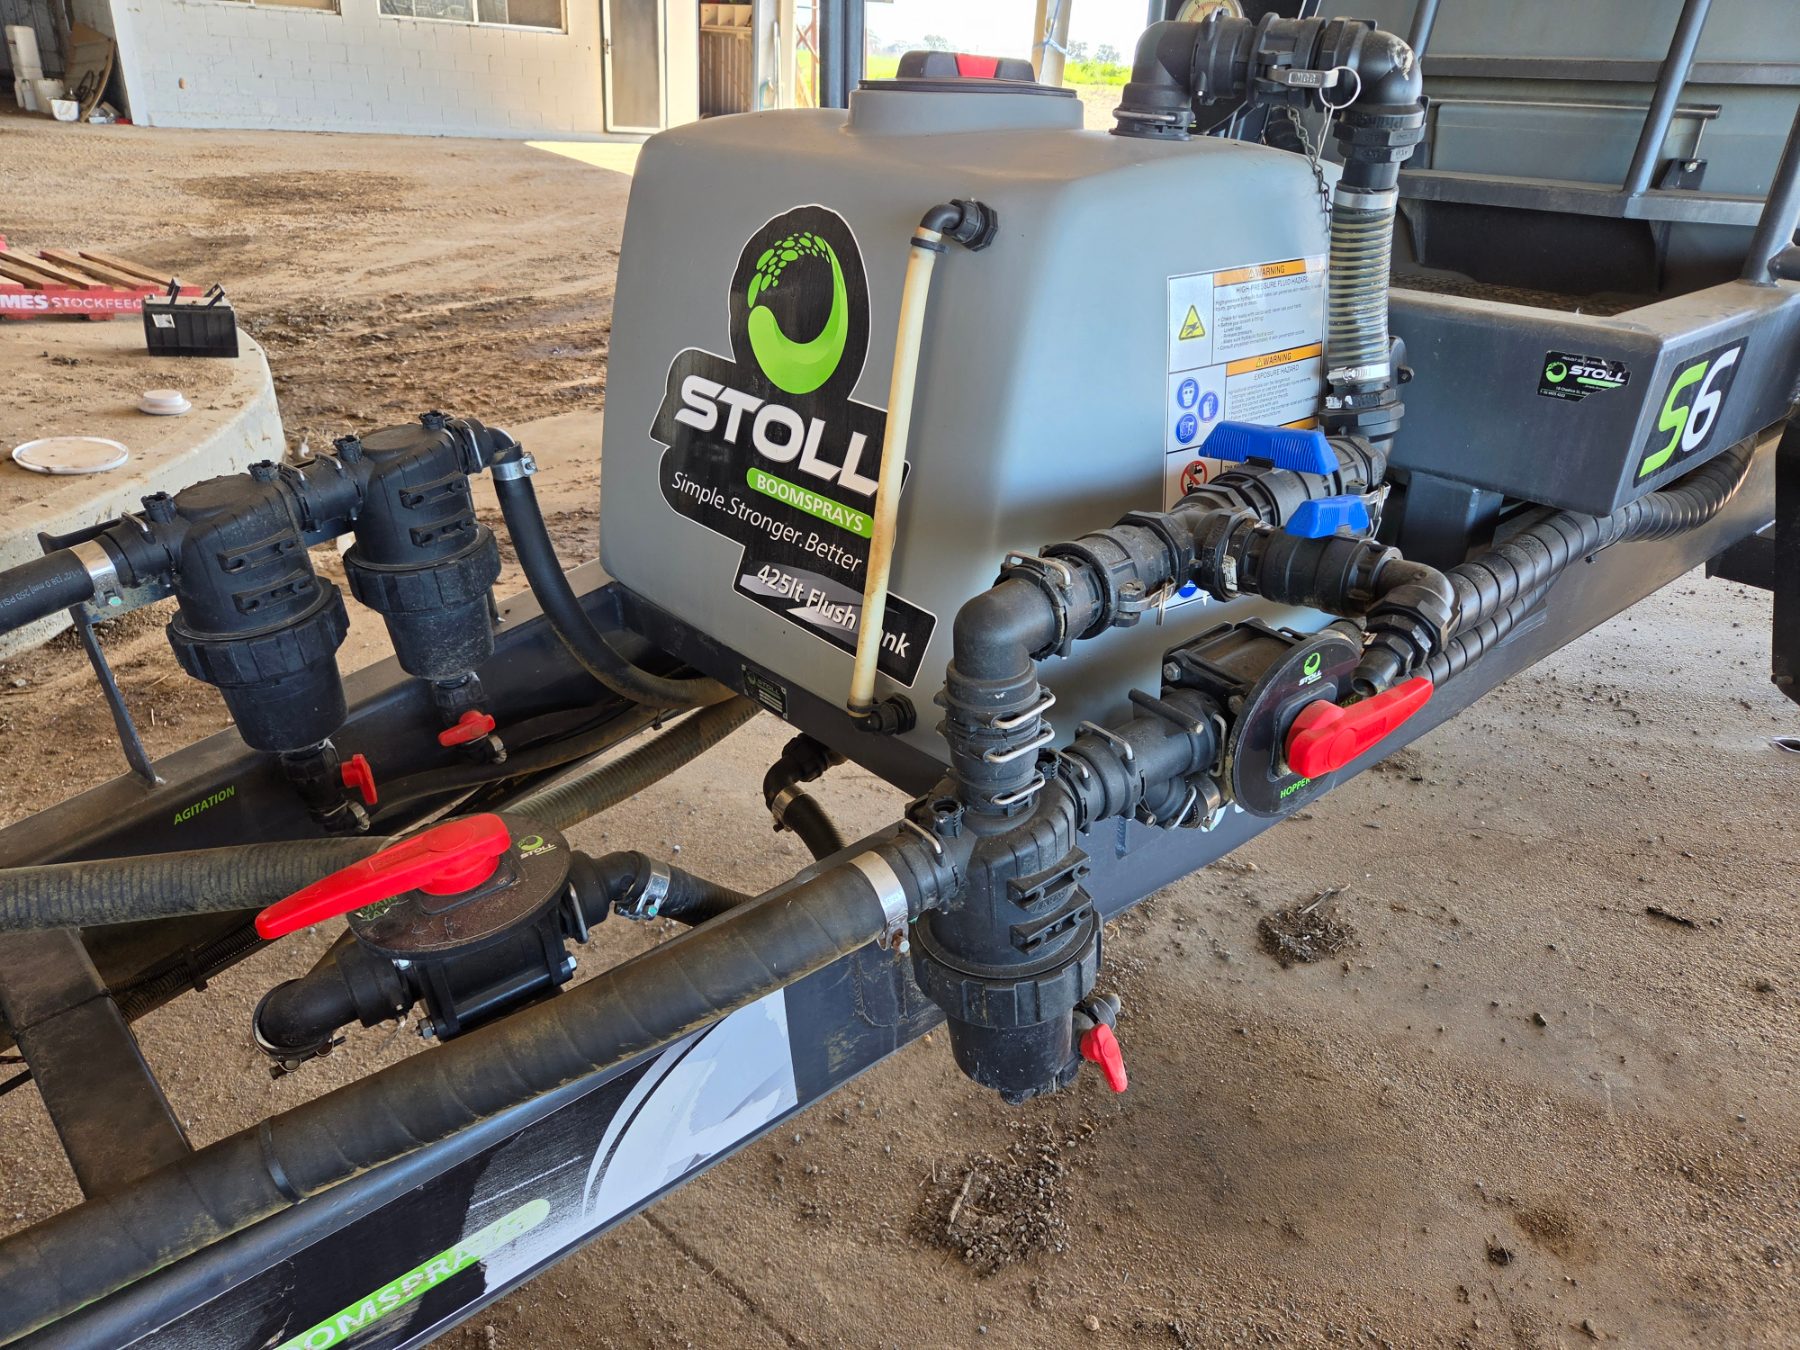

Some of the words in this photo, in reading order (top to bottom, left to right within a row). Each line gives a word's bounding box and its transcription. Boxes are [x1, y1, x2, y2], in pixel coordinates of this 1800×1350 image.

[1256, 265, 1285, 278] WARNING
[0, 295, 48, 309] MES
[1263, 352, 1292, 366] WARNING
[1254, 369, 1279, 381] EXPOSURE
[1280, 364, 1299, 375] HAZARD
[1569, 365, 1626, 382] STOLL
[1639, 347, 1740, 478] S6
[674, 375, 879, 496] STOLL
[756, 474, 864, 532] BOOMSPRAYS
[806, 588, 857, 630] Flush
[881, 630, 911, 658] nk
[1280, 777, 1311, 799] HOPPER
[174, 785, 235, 825] AGITATION
[520, 843, 556, 860] STOLL
